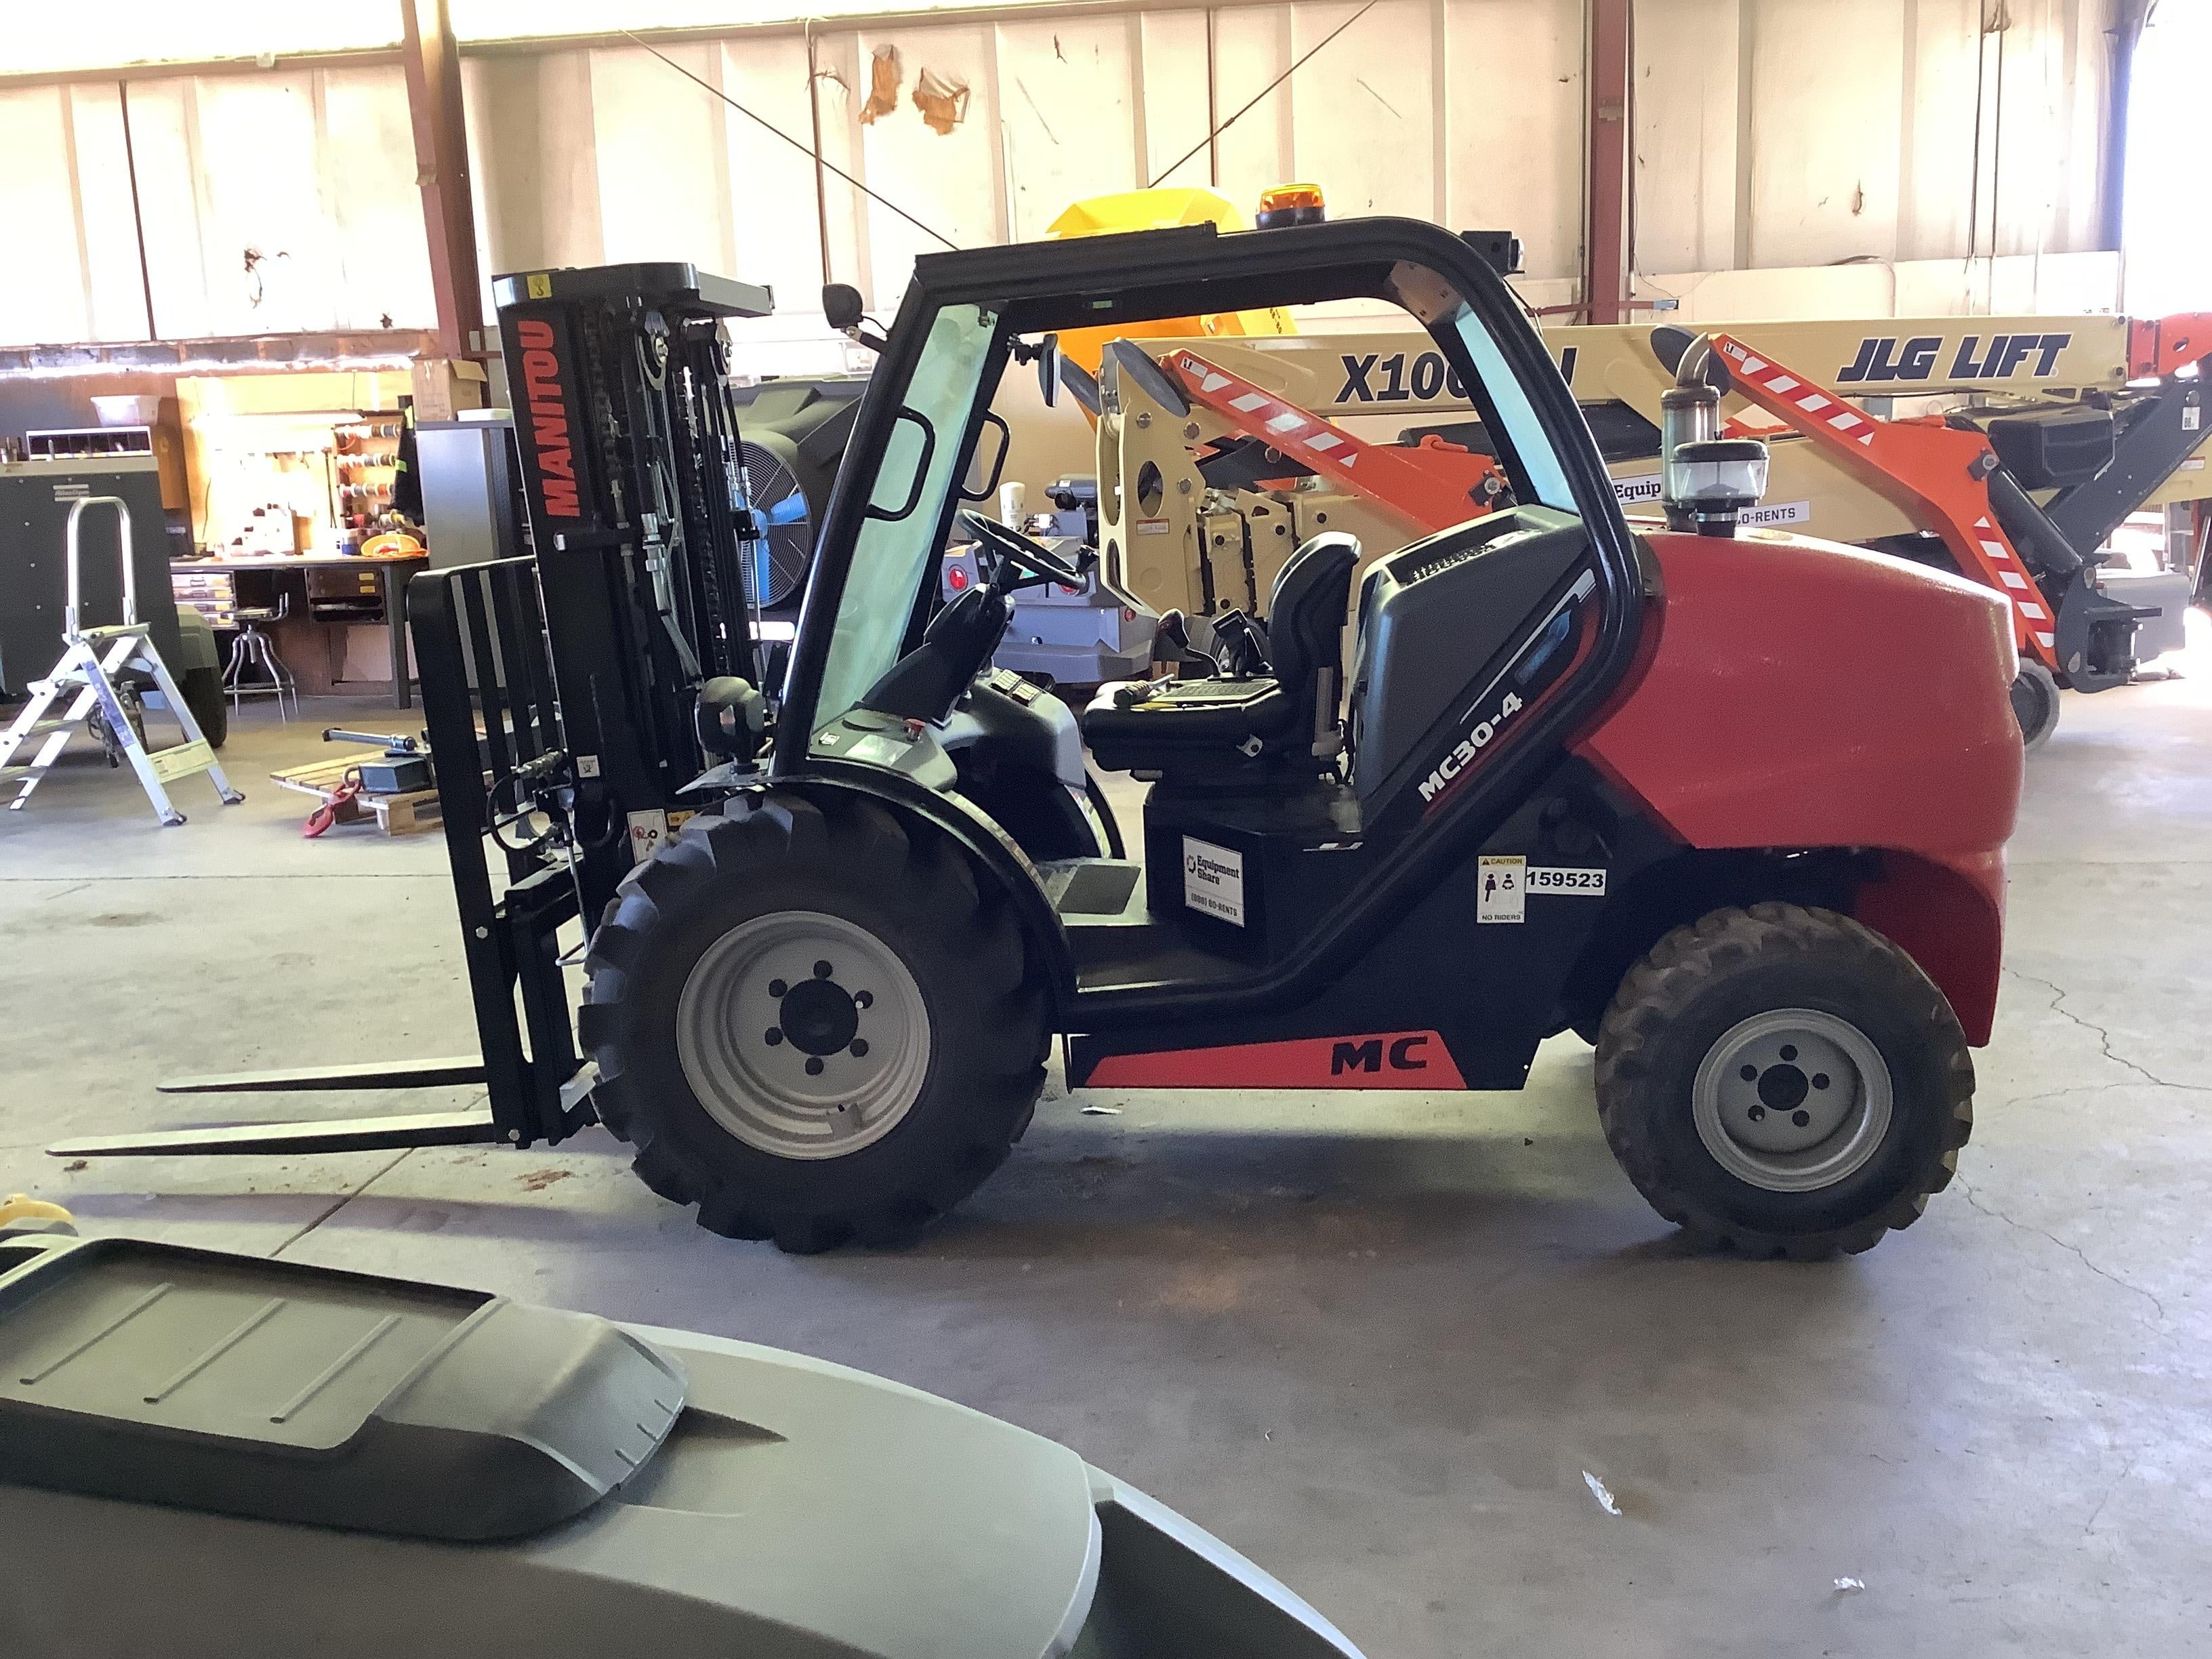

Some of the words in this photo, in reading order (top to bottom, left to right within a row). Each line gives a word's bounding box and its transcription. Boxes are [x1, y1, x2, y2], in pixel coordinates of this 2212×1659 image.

[1835, 336, 1944, 382] JLG
[1948, 333, 2071, 380] LIFT
[518, 321, 581, 516] MANITOU
[1737, 508, 1795, 525] O-RENTS
[1418, 691, 1523, 802] MC30-4
[1197, 855, 1240, 879] Equipment
[1197, 868, 1220, 885] Share
[1526, 872, 1604, 888] 159523
[1331, 1036, 1428, 1076] MC
